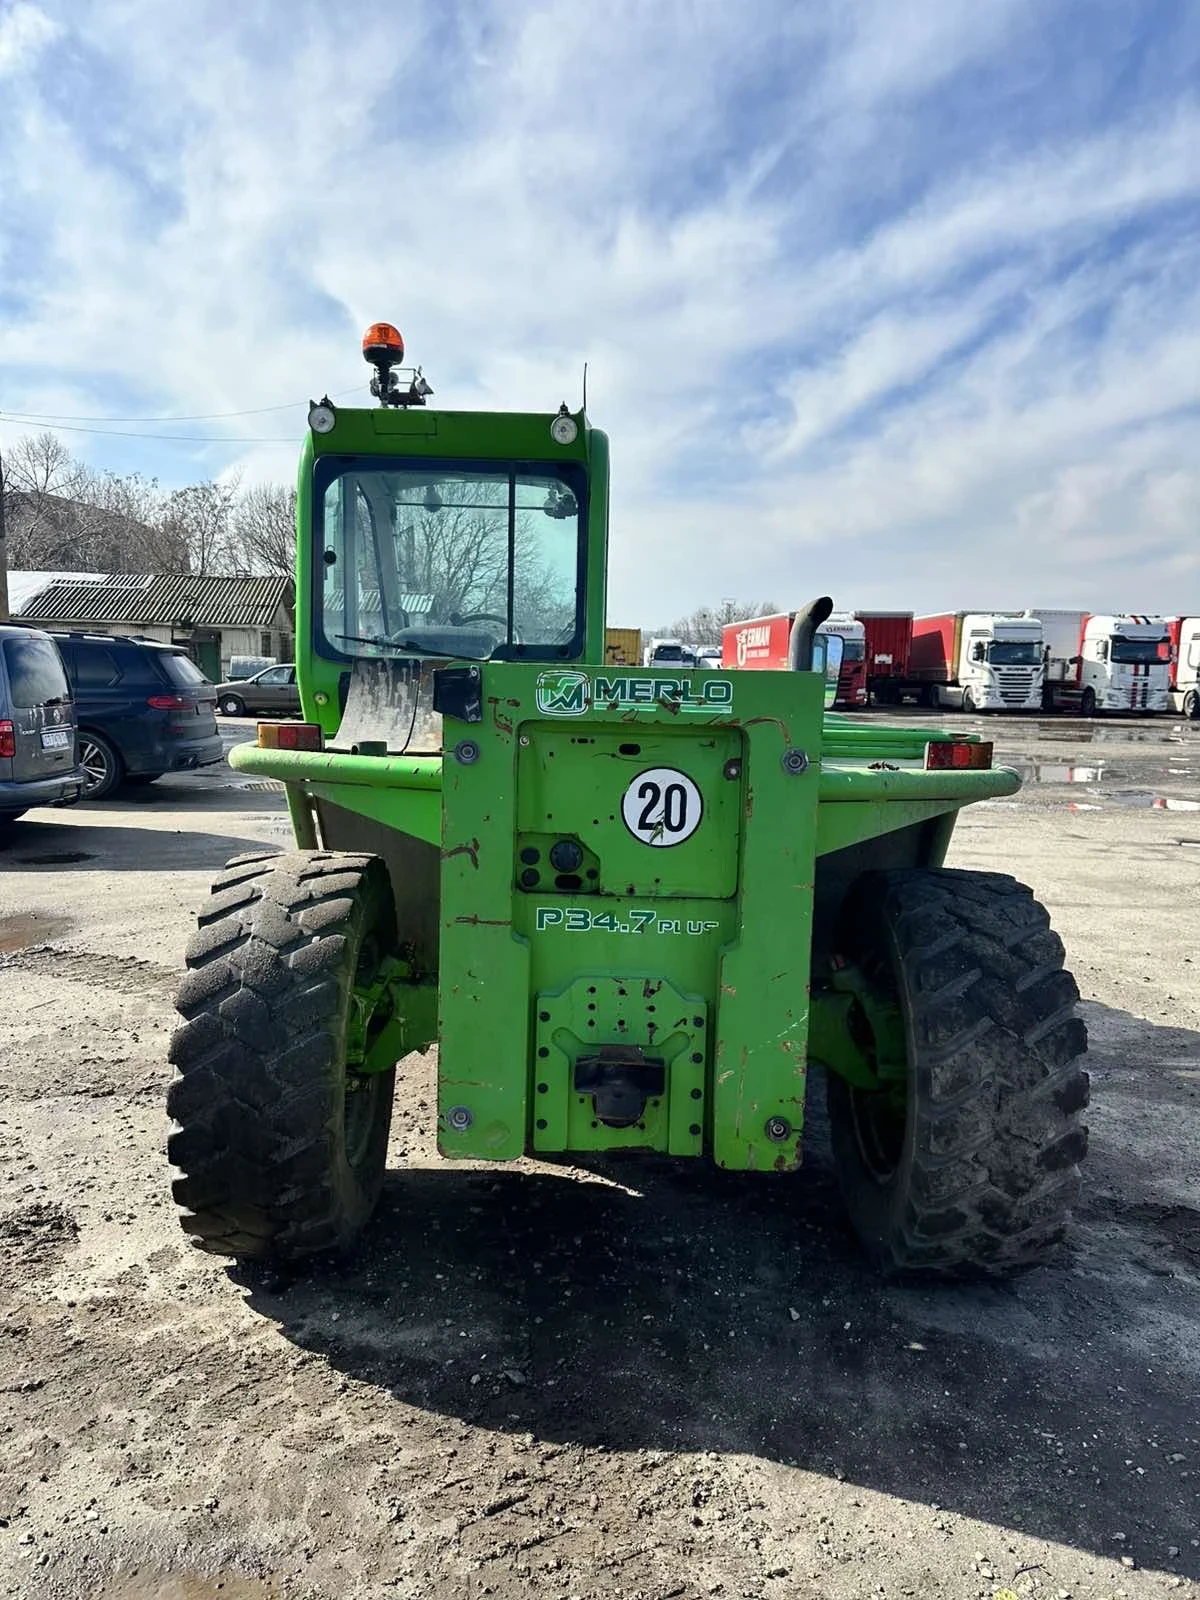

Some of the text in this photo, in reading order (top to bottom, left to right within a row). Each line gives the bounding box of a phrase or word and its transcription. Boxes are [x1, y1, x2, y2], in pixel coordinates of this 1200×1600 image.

[594, 677, 733, 704] MERLO
[637, 781, 688, 832] 20
[536, 907, 657, 934] P34.7
